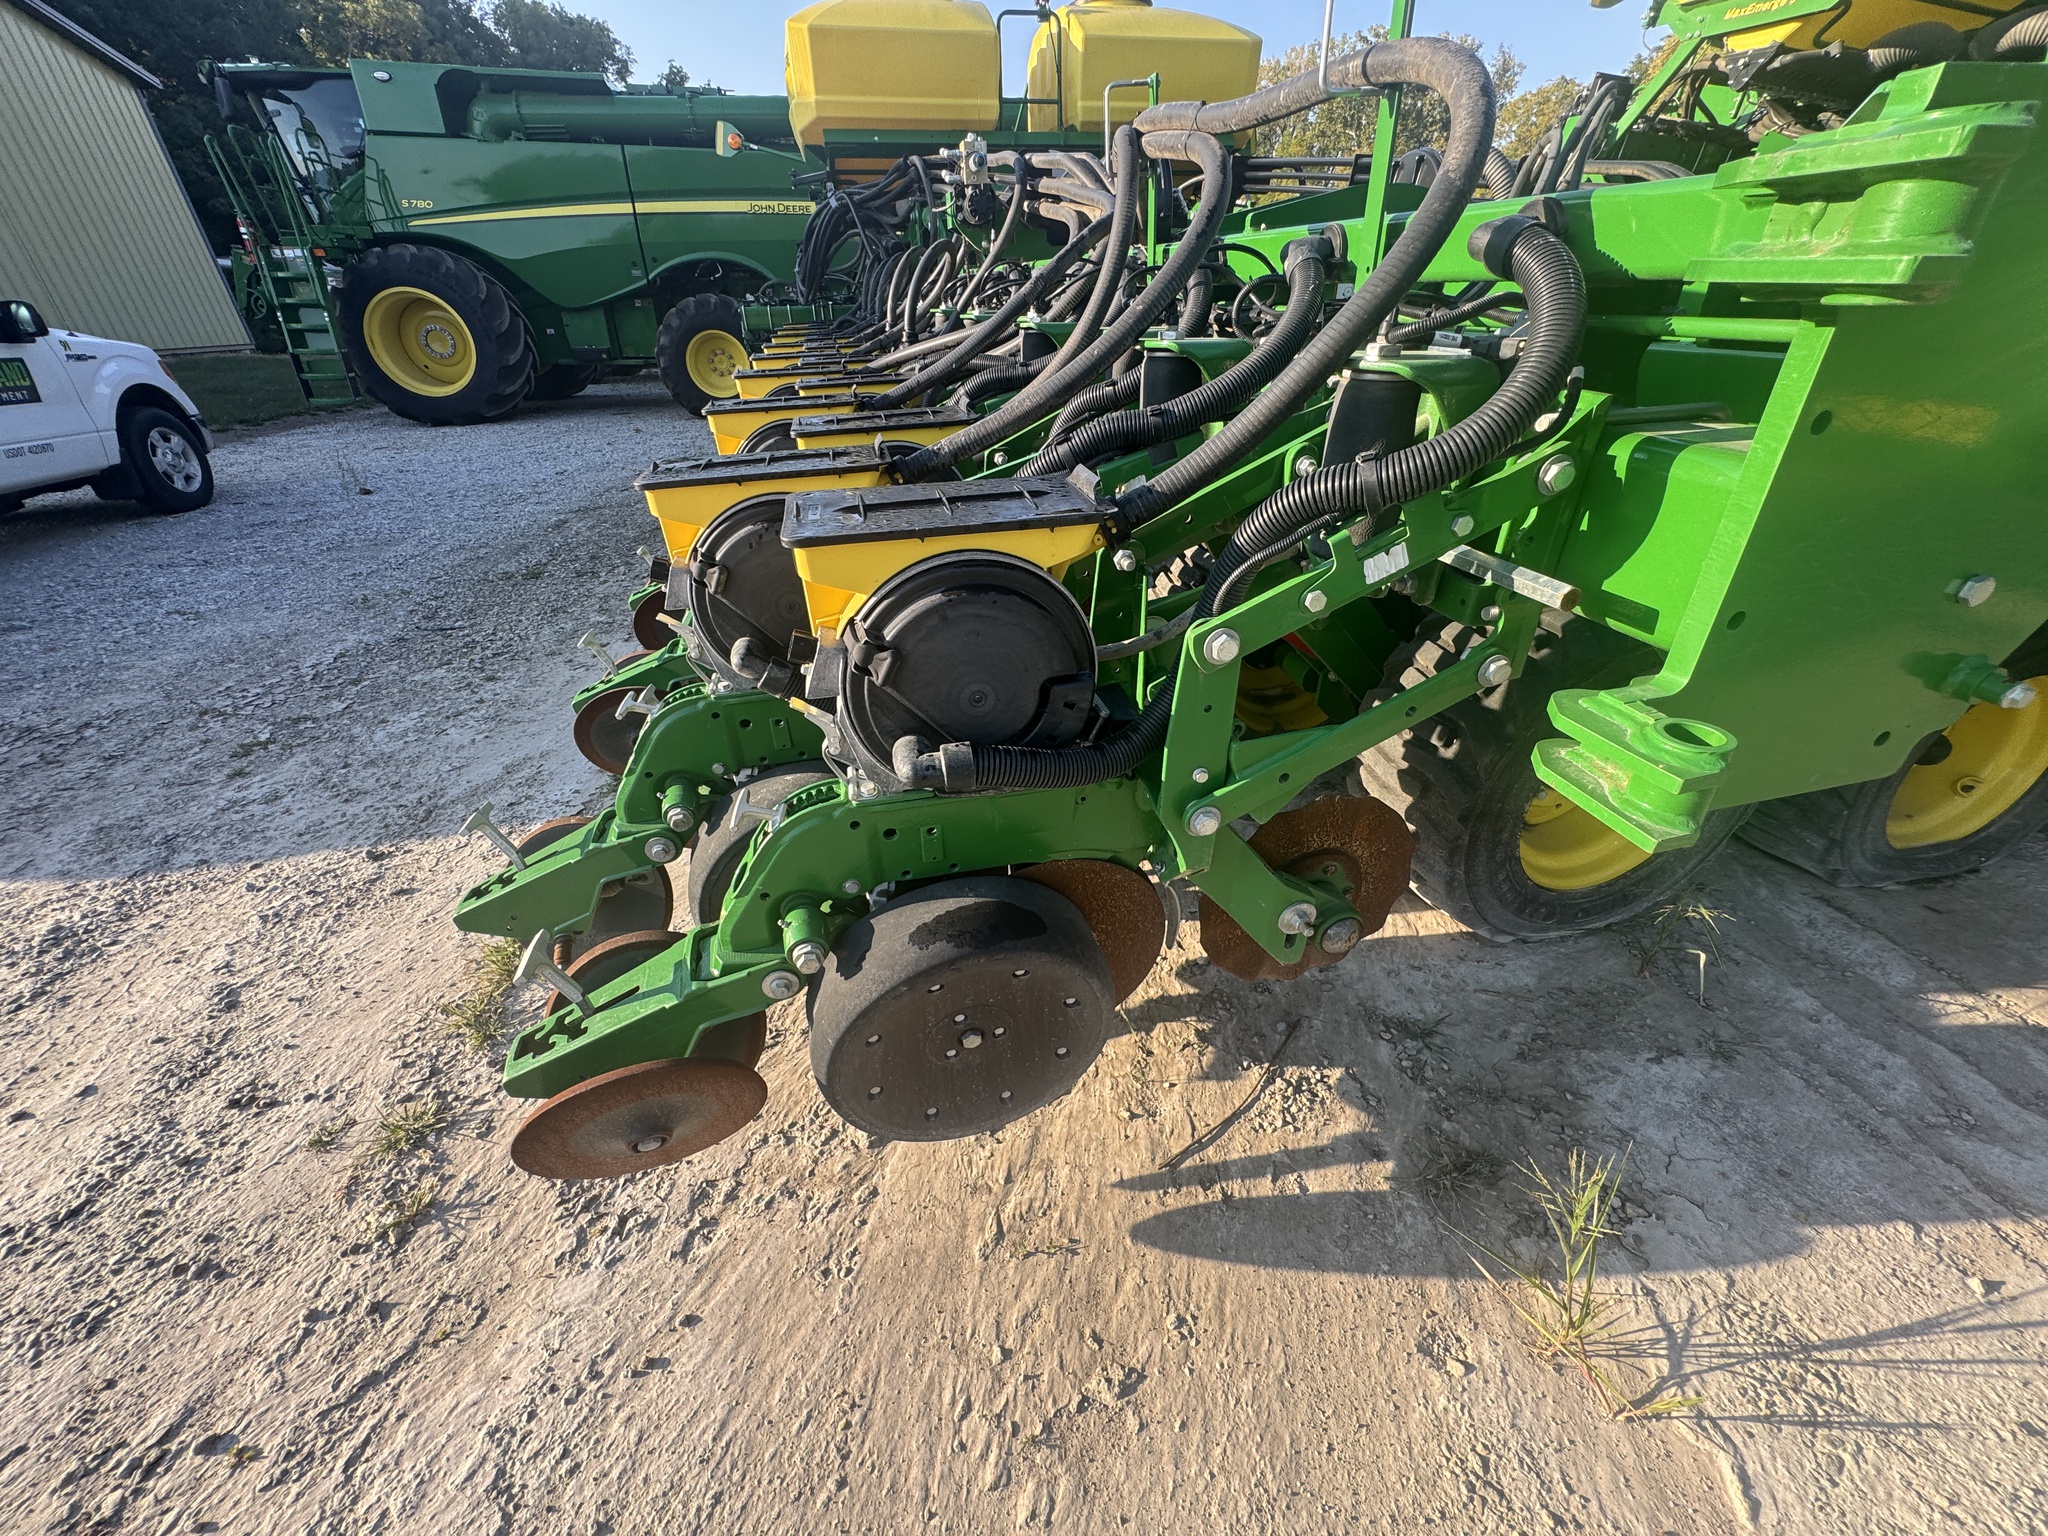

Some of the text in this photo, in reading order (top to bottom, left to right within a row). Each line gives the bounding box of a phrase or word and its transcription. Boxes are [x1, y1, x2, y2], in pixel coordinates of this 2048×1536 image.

[747, 202, 812, 213] JOHN DEERE
[3, 446, 26, 459] USDOT
